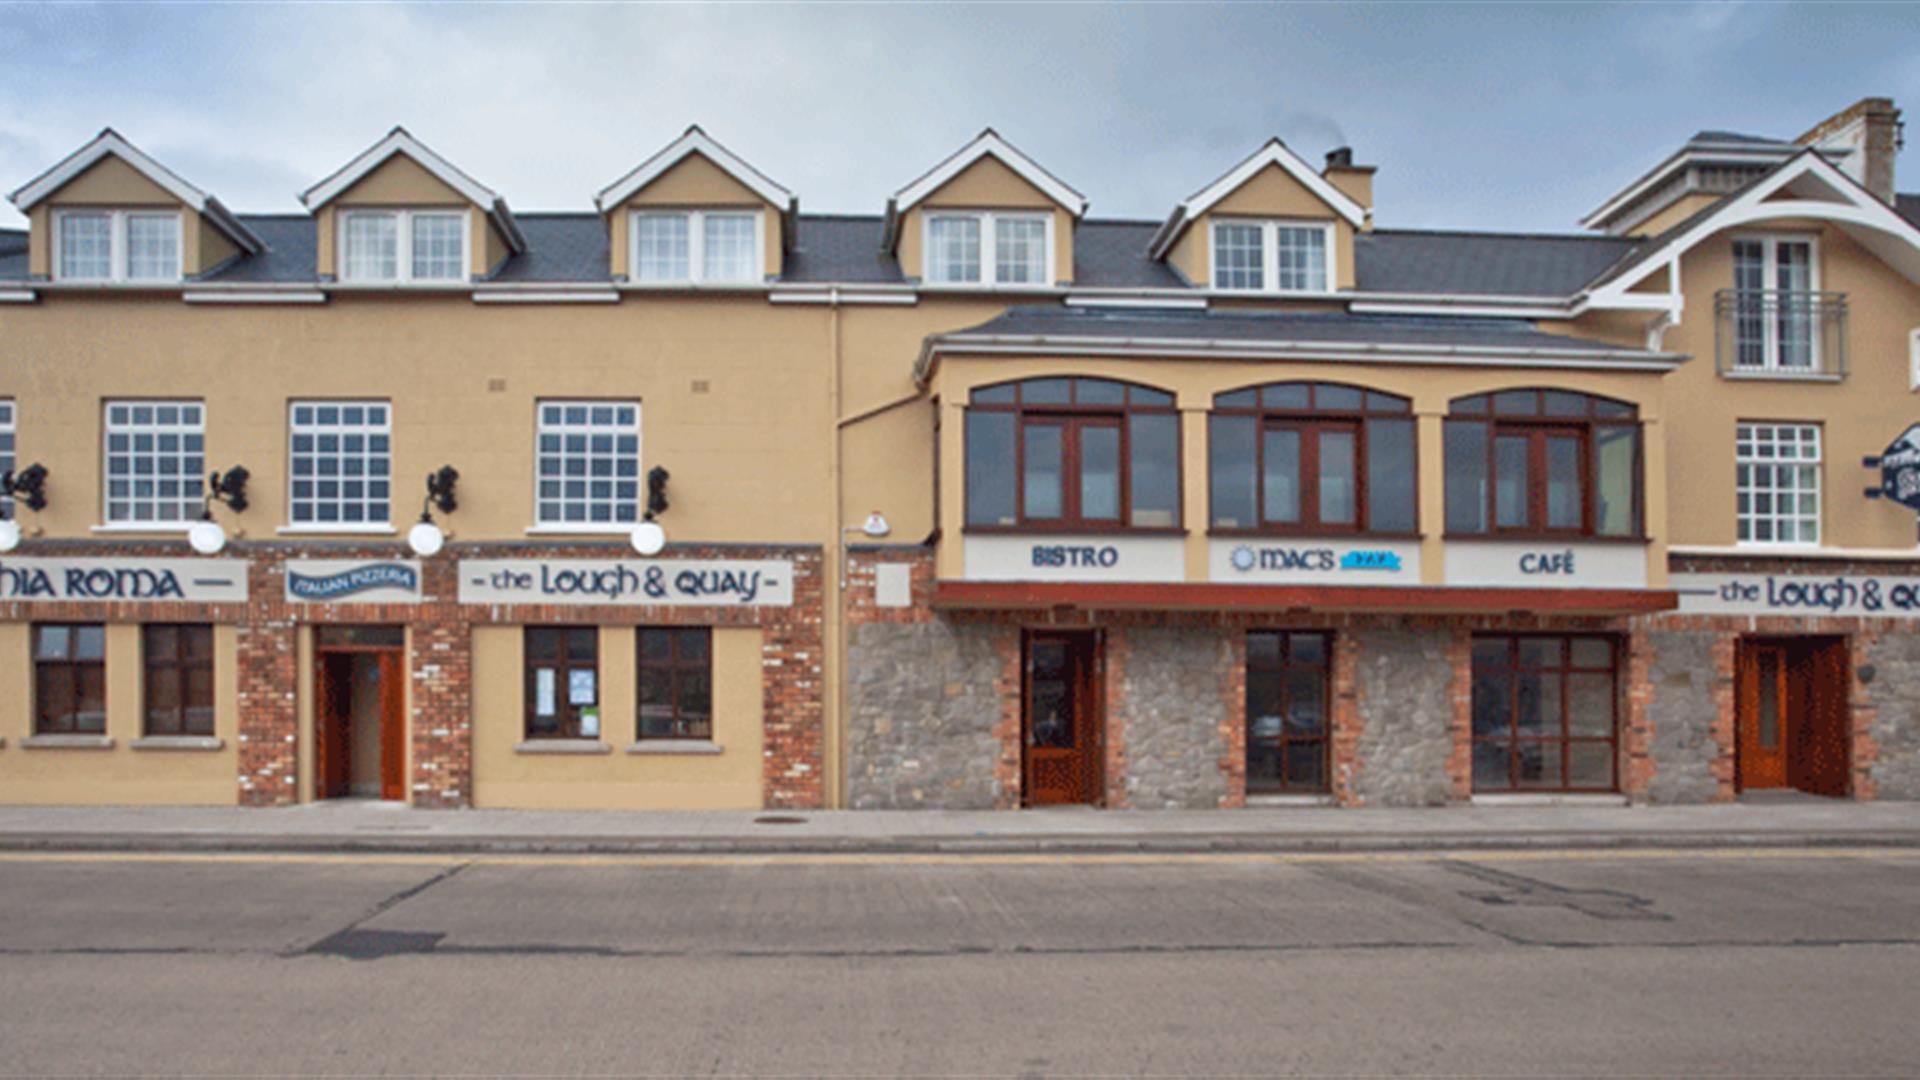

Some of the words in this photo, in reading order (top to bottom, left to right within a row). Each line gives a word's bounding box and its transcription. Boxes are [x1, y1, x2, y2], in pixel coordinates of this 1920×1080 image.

[1031, 546, 1119, 568] BISTRO
[1259, 548, 1335, 571] MAC'S
[1519, 549, 1575, 574] CAFÉ
[64, 568, 185, 598] ROMA
[294, 576, 350, 594] ITALIAN
[350, 565, 412, 586] PIZZERIA
[491, 569, 533, 590] the
[540, 564, 638, 599] Lough
[643, 566, 666, 598] &
[1720, 580, 1760, 602] the
[1766, 576, 1858, 612] Lough
[1862, 578, 1885, 611] &
